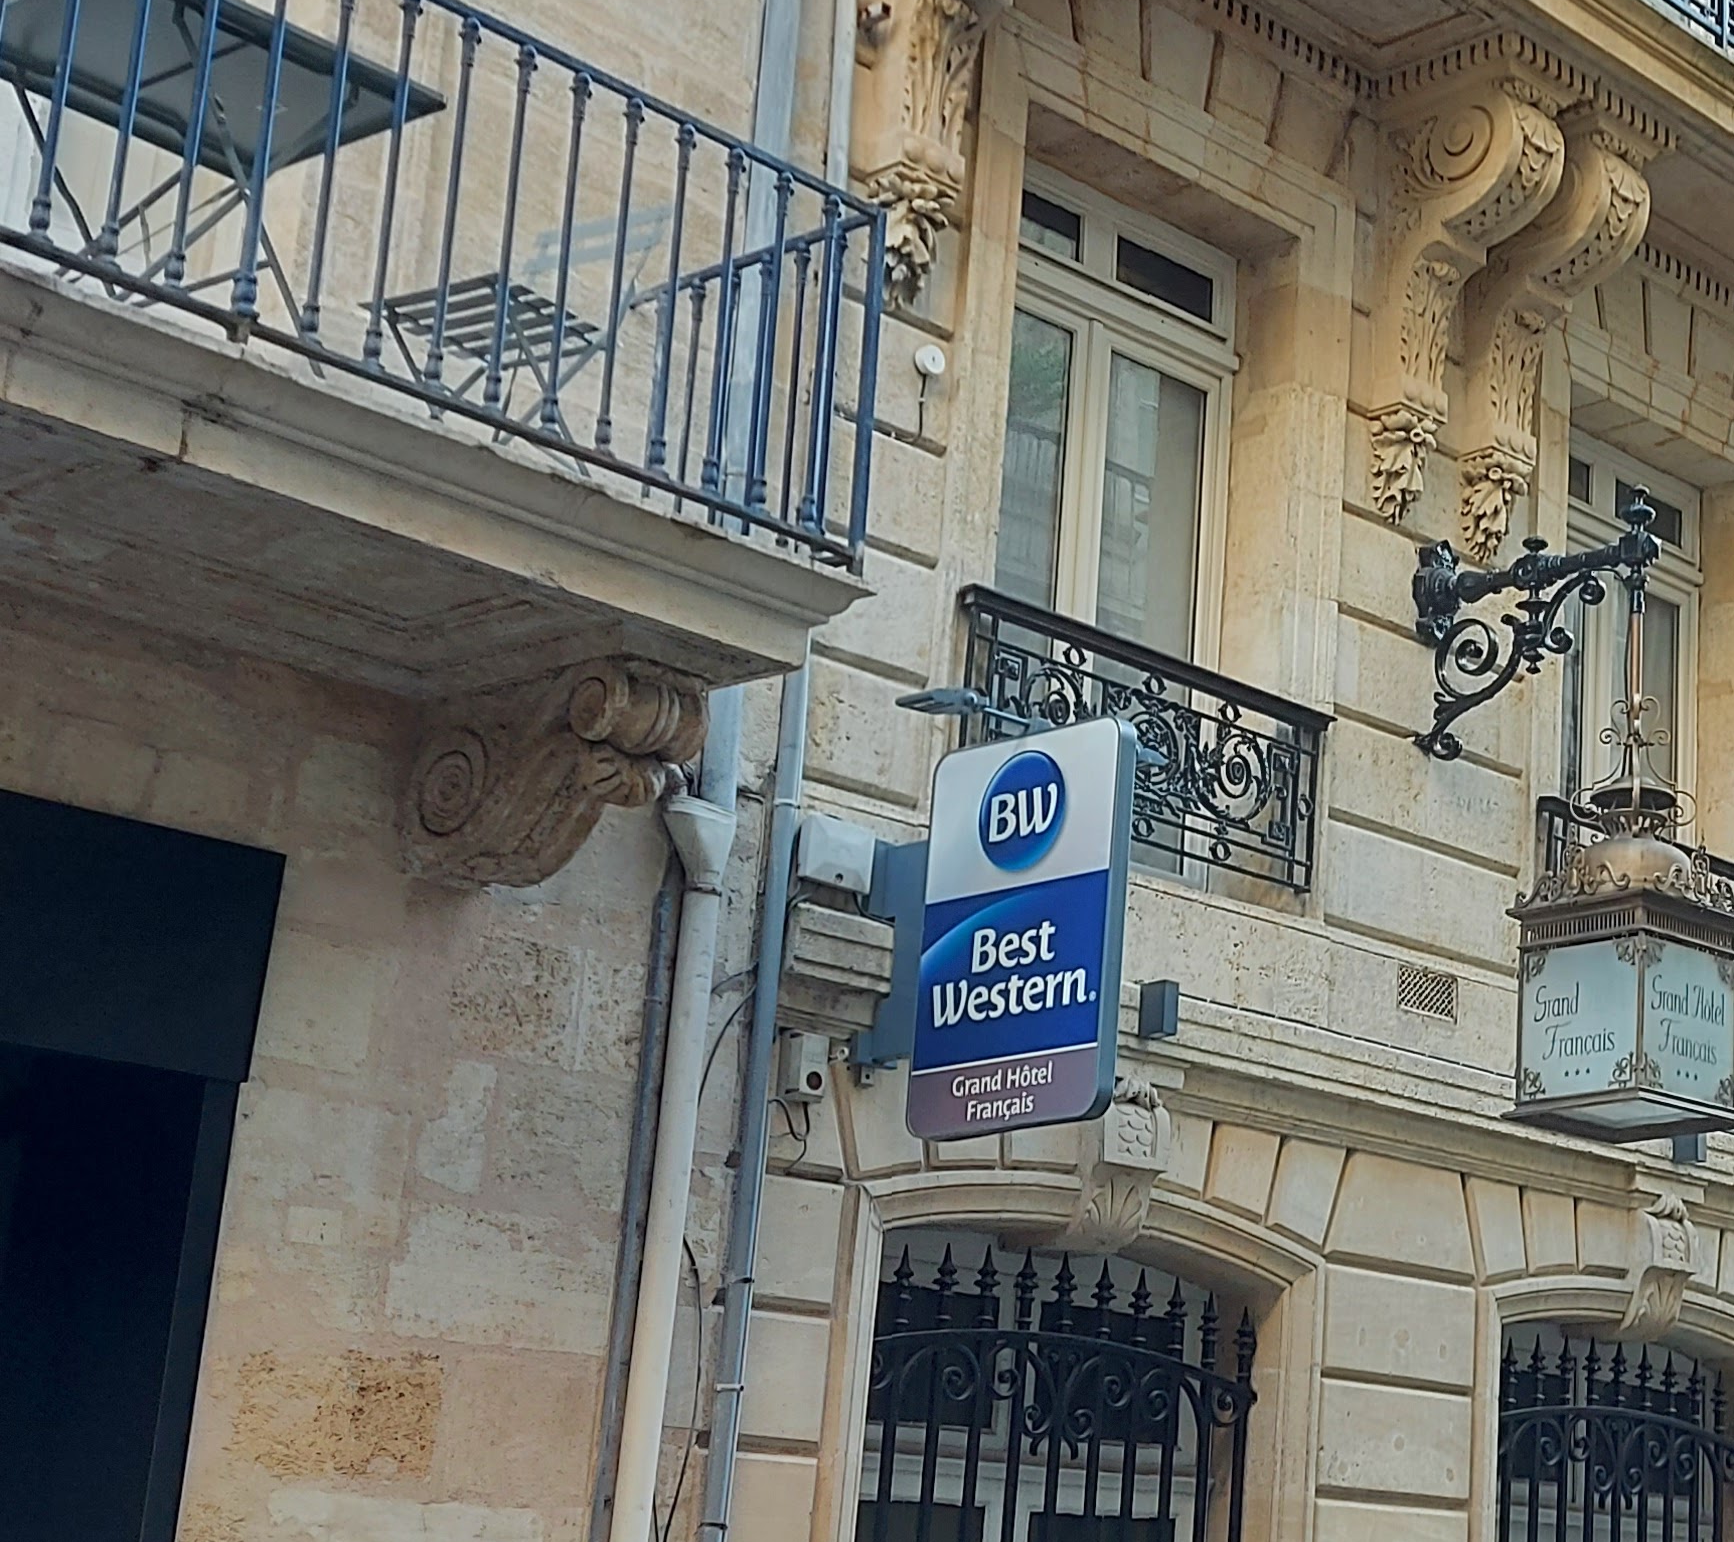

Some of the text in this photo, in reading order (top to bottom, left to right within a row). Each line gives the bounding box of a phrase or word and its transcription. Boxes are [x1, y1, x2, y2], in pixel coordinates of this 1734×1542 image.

[988, 783, 1058, 843] BW
[971, 919, 1056, 974] Best
[932, 966, 1087, 1028] Western
[1534, 981, 1580, 1022] Grand
[1650, 974, 1689, 1017] Grand
[1542, 1021, 1616, 1061] Français
[1658, 1018, 1717, 1066] Français
[952, 1060, 1053, 1096] Grand Hôtel
[965, 1091, 1034, 1121] Français
